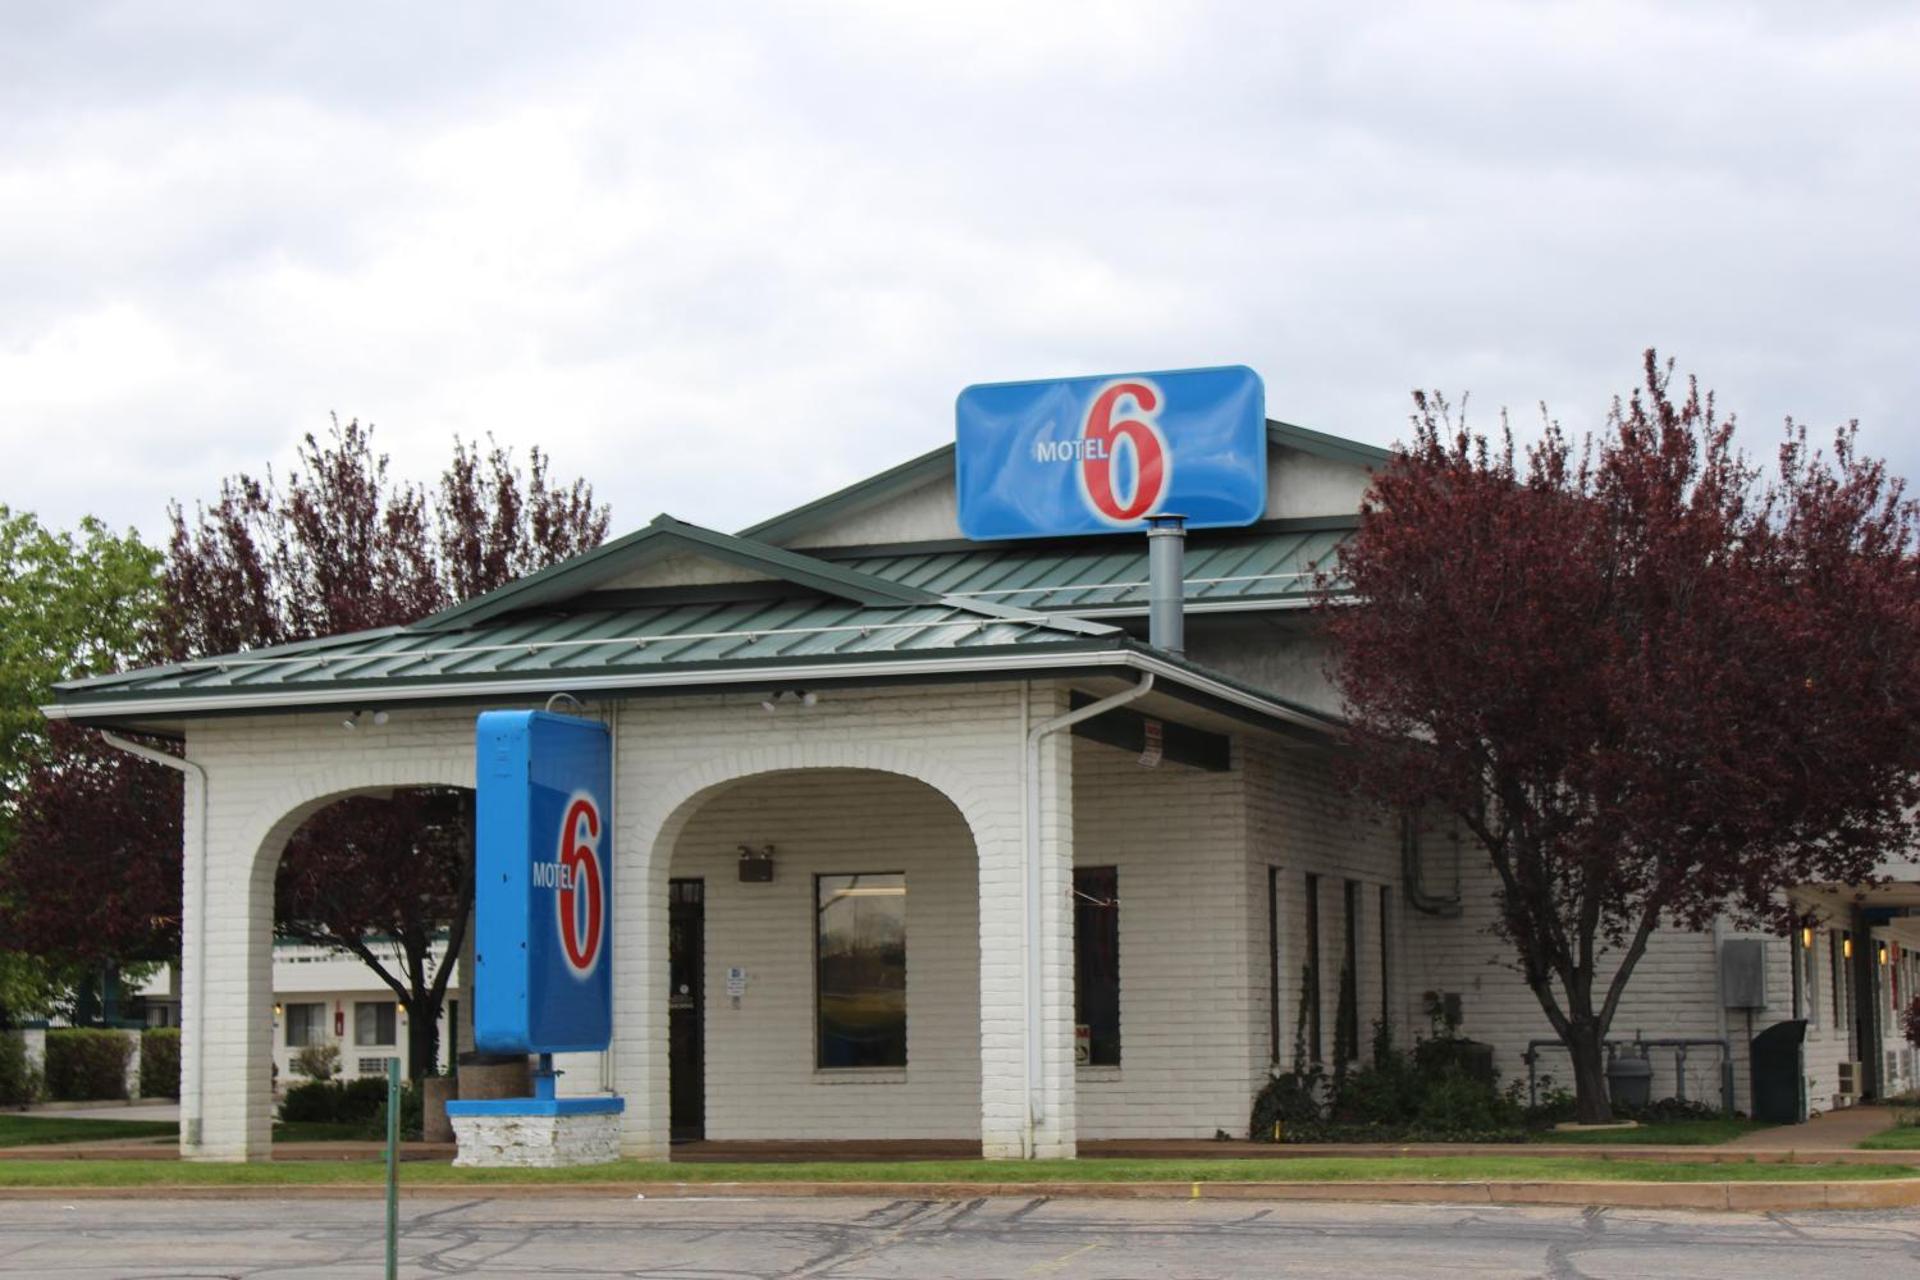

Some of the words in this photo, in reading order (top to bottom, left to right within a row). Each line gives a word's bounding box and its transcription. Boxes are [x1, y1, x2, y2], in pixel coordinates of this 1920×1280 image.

[1037, 438, 1108, 463] MOTEL
[1080, 380, 1167, 524] 6
[533, 862, 574, 889] MOTEL
[557, 796, 602, 972] 6
